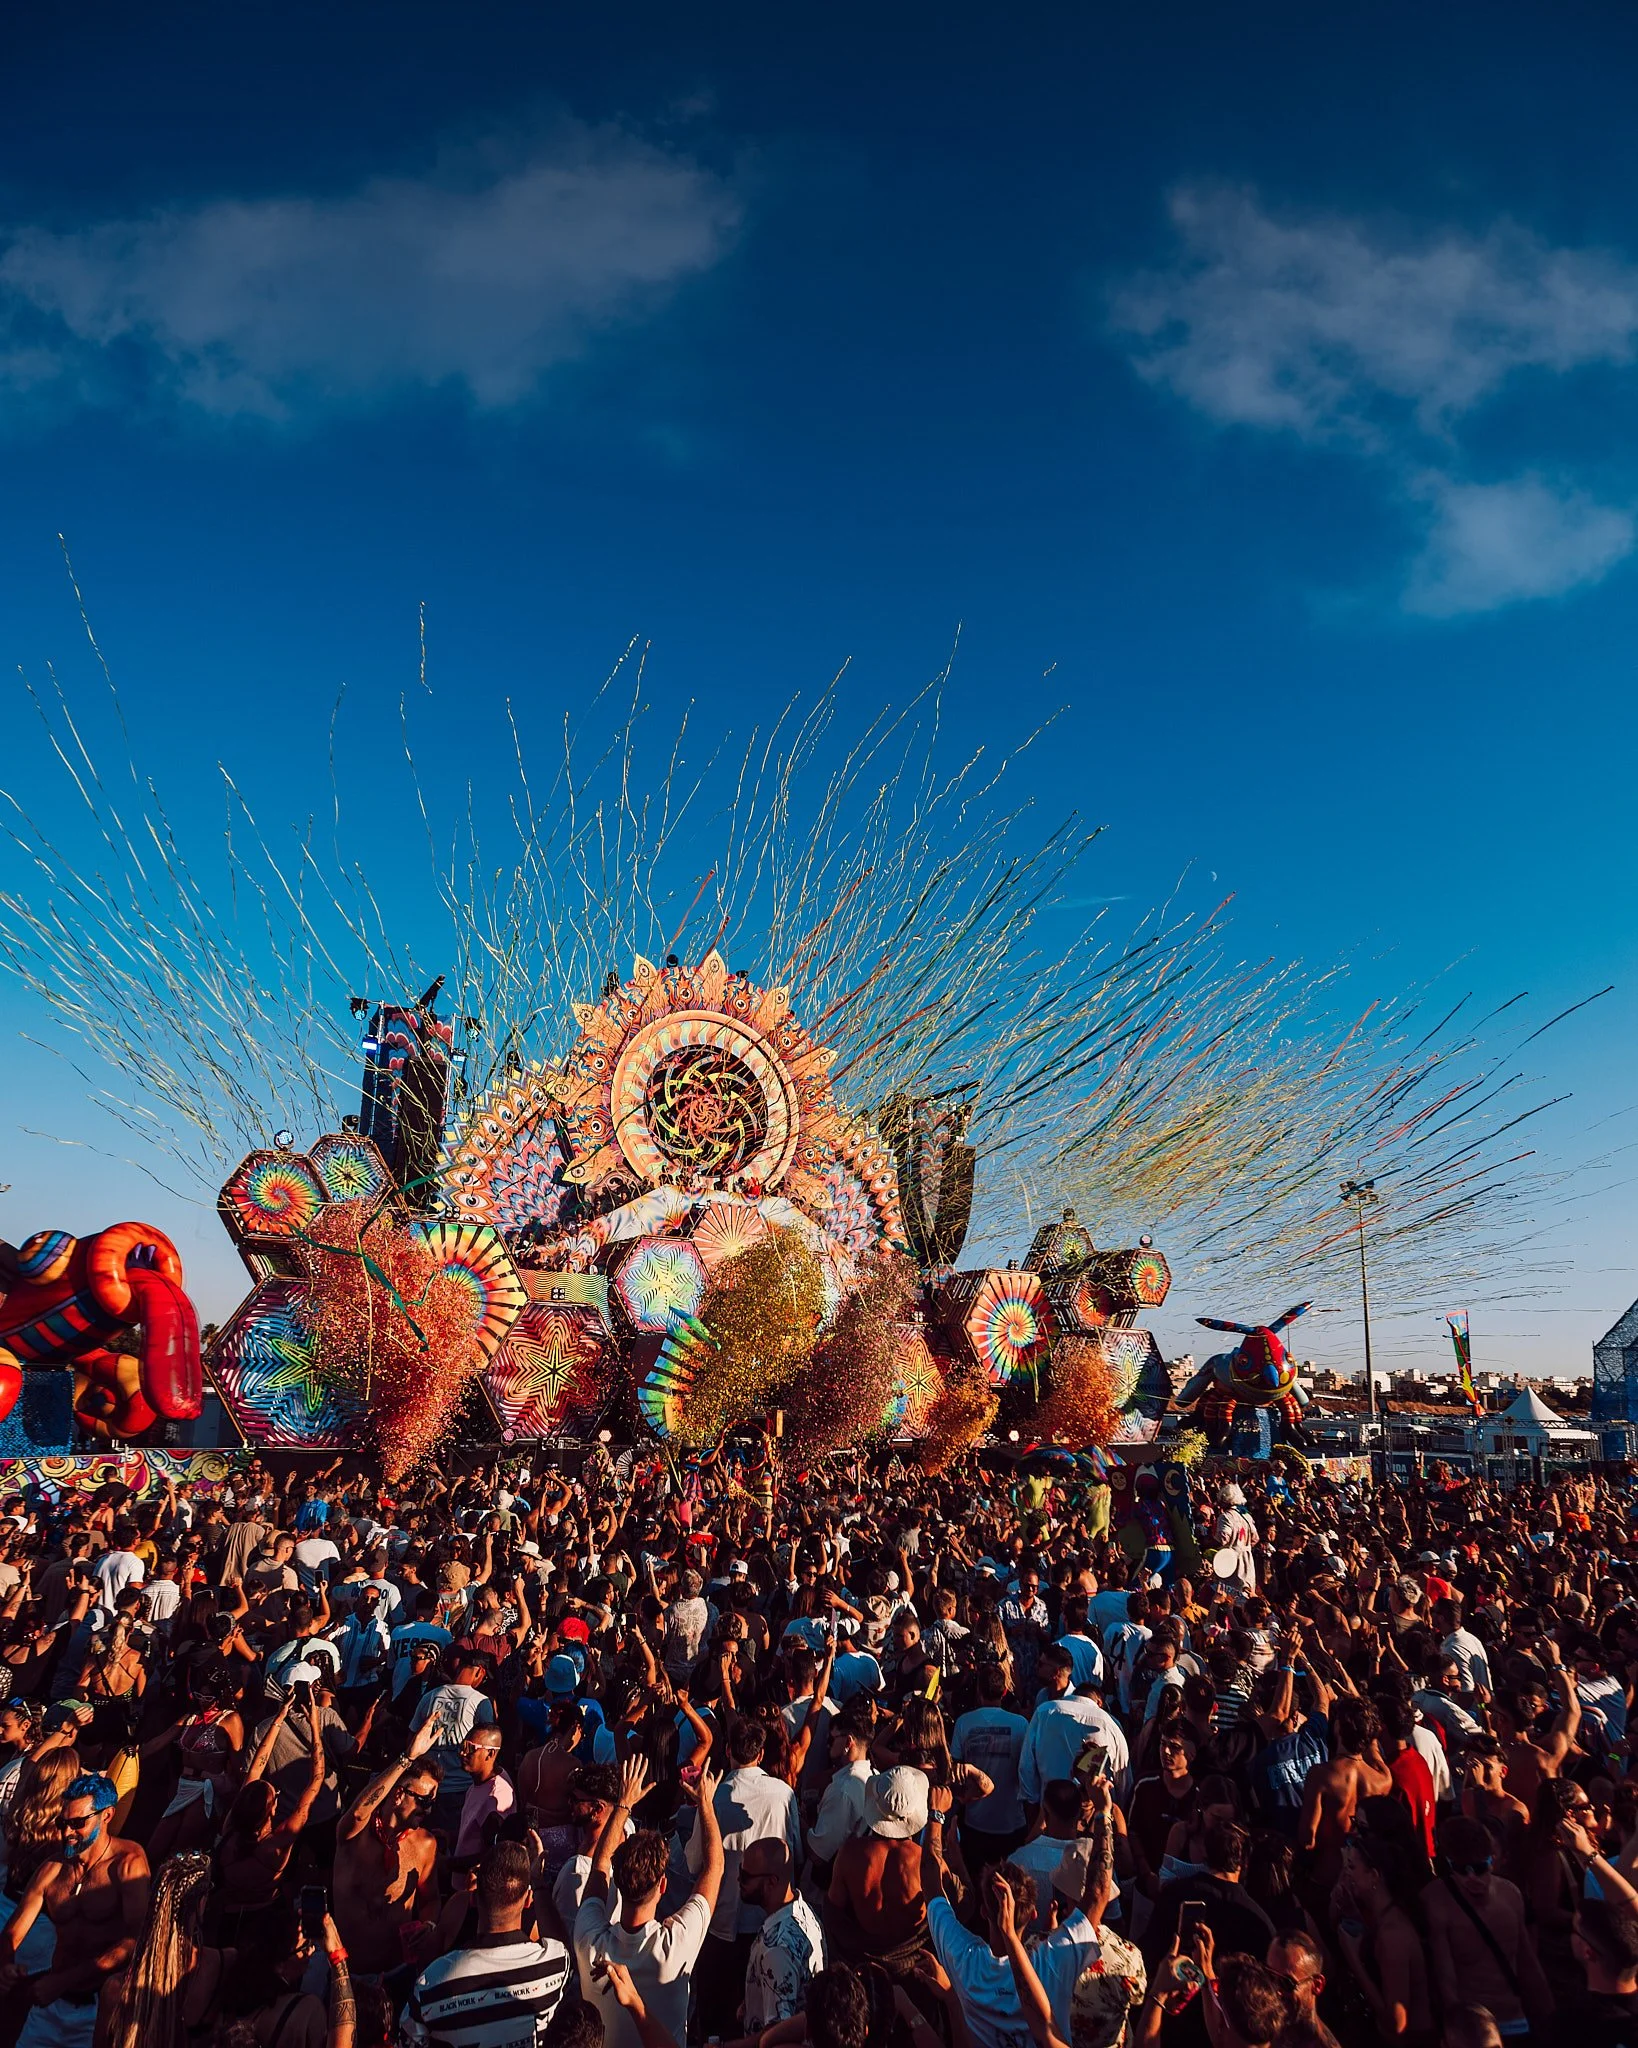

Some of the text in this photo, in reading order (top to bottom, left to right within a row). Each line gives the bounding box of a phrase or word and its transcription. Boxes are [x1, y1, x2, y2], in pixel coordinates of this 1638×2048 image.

[494, 1987, 530, 2000] BLACK WORK
[439, 1997, 476, 2012] BLACK WORK
